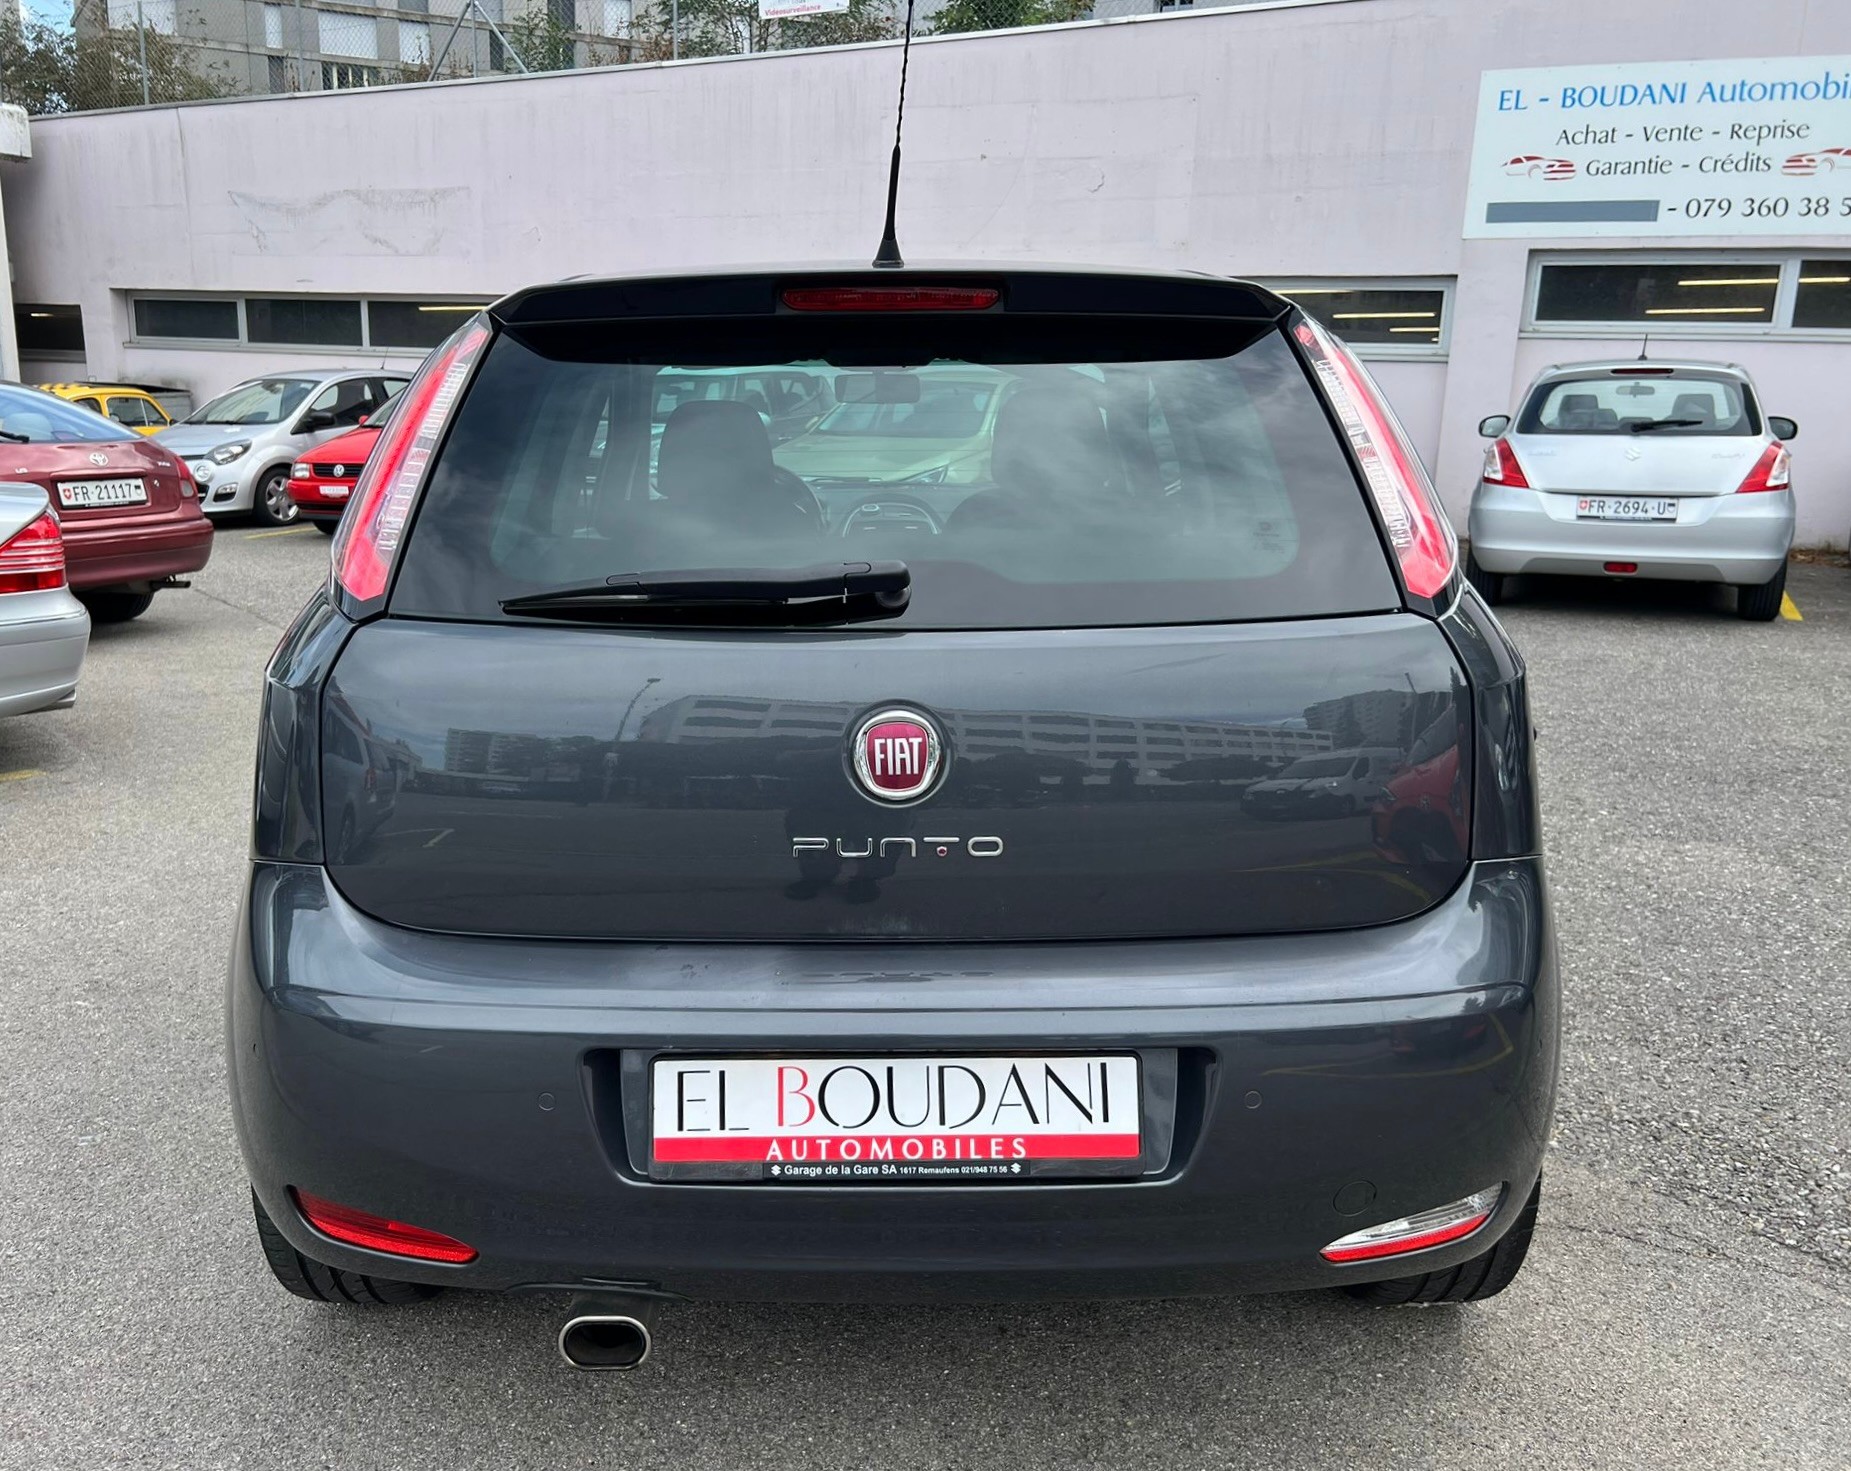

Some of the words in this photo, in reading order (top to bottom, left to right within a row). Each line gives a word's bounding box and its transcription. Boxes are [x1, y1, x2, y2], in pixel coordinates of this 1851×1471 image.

[1498, 89, 1528, 111] EL
[1560, 82, 1687, 109] BOUDANI
[1696, 71, 1851, 104] Automobi
[1555, 124, 1617, 146] Achat
[1643, 123, 1704, 143] Vente
[1729, 119, 1811, 146] Reprise
[1585, 155, 1673, 177] Garantie
[1698, 151, 1772, 174] Crédits
[1685, 198, 1732, 219] 079
[1741, 197, 1789, 217] 360
[1798, 197, 1830, 217] 38
[874, 737, 923, 776] FIAT
[792, 836, 1004, 858] PUNTO
[676, 1069, 750, 1133] EL
[776, 1062, 1111, 1130] BOUDANI
[766, 1137, 1027, 1161] AUTOMOBILES
[784, 1165, 823, 1177] Garage
[825, 1165, 838, 1175] de
[841, 1165, 851, 1175] la
[853, 1164, 879, 1175] Gare
[881, 1164, 898, 1175] SA
[899, 1166, 917, 1174] 1617
[918, 1166, 960, 1174] Remaufens
